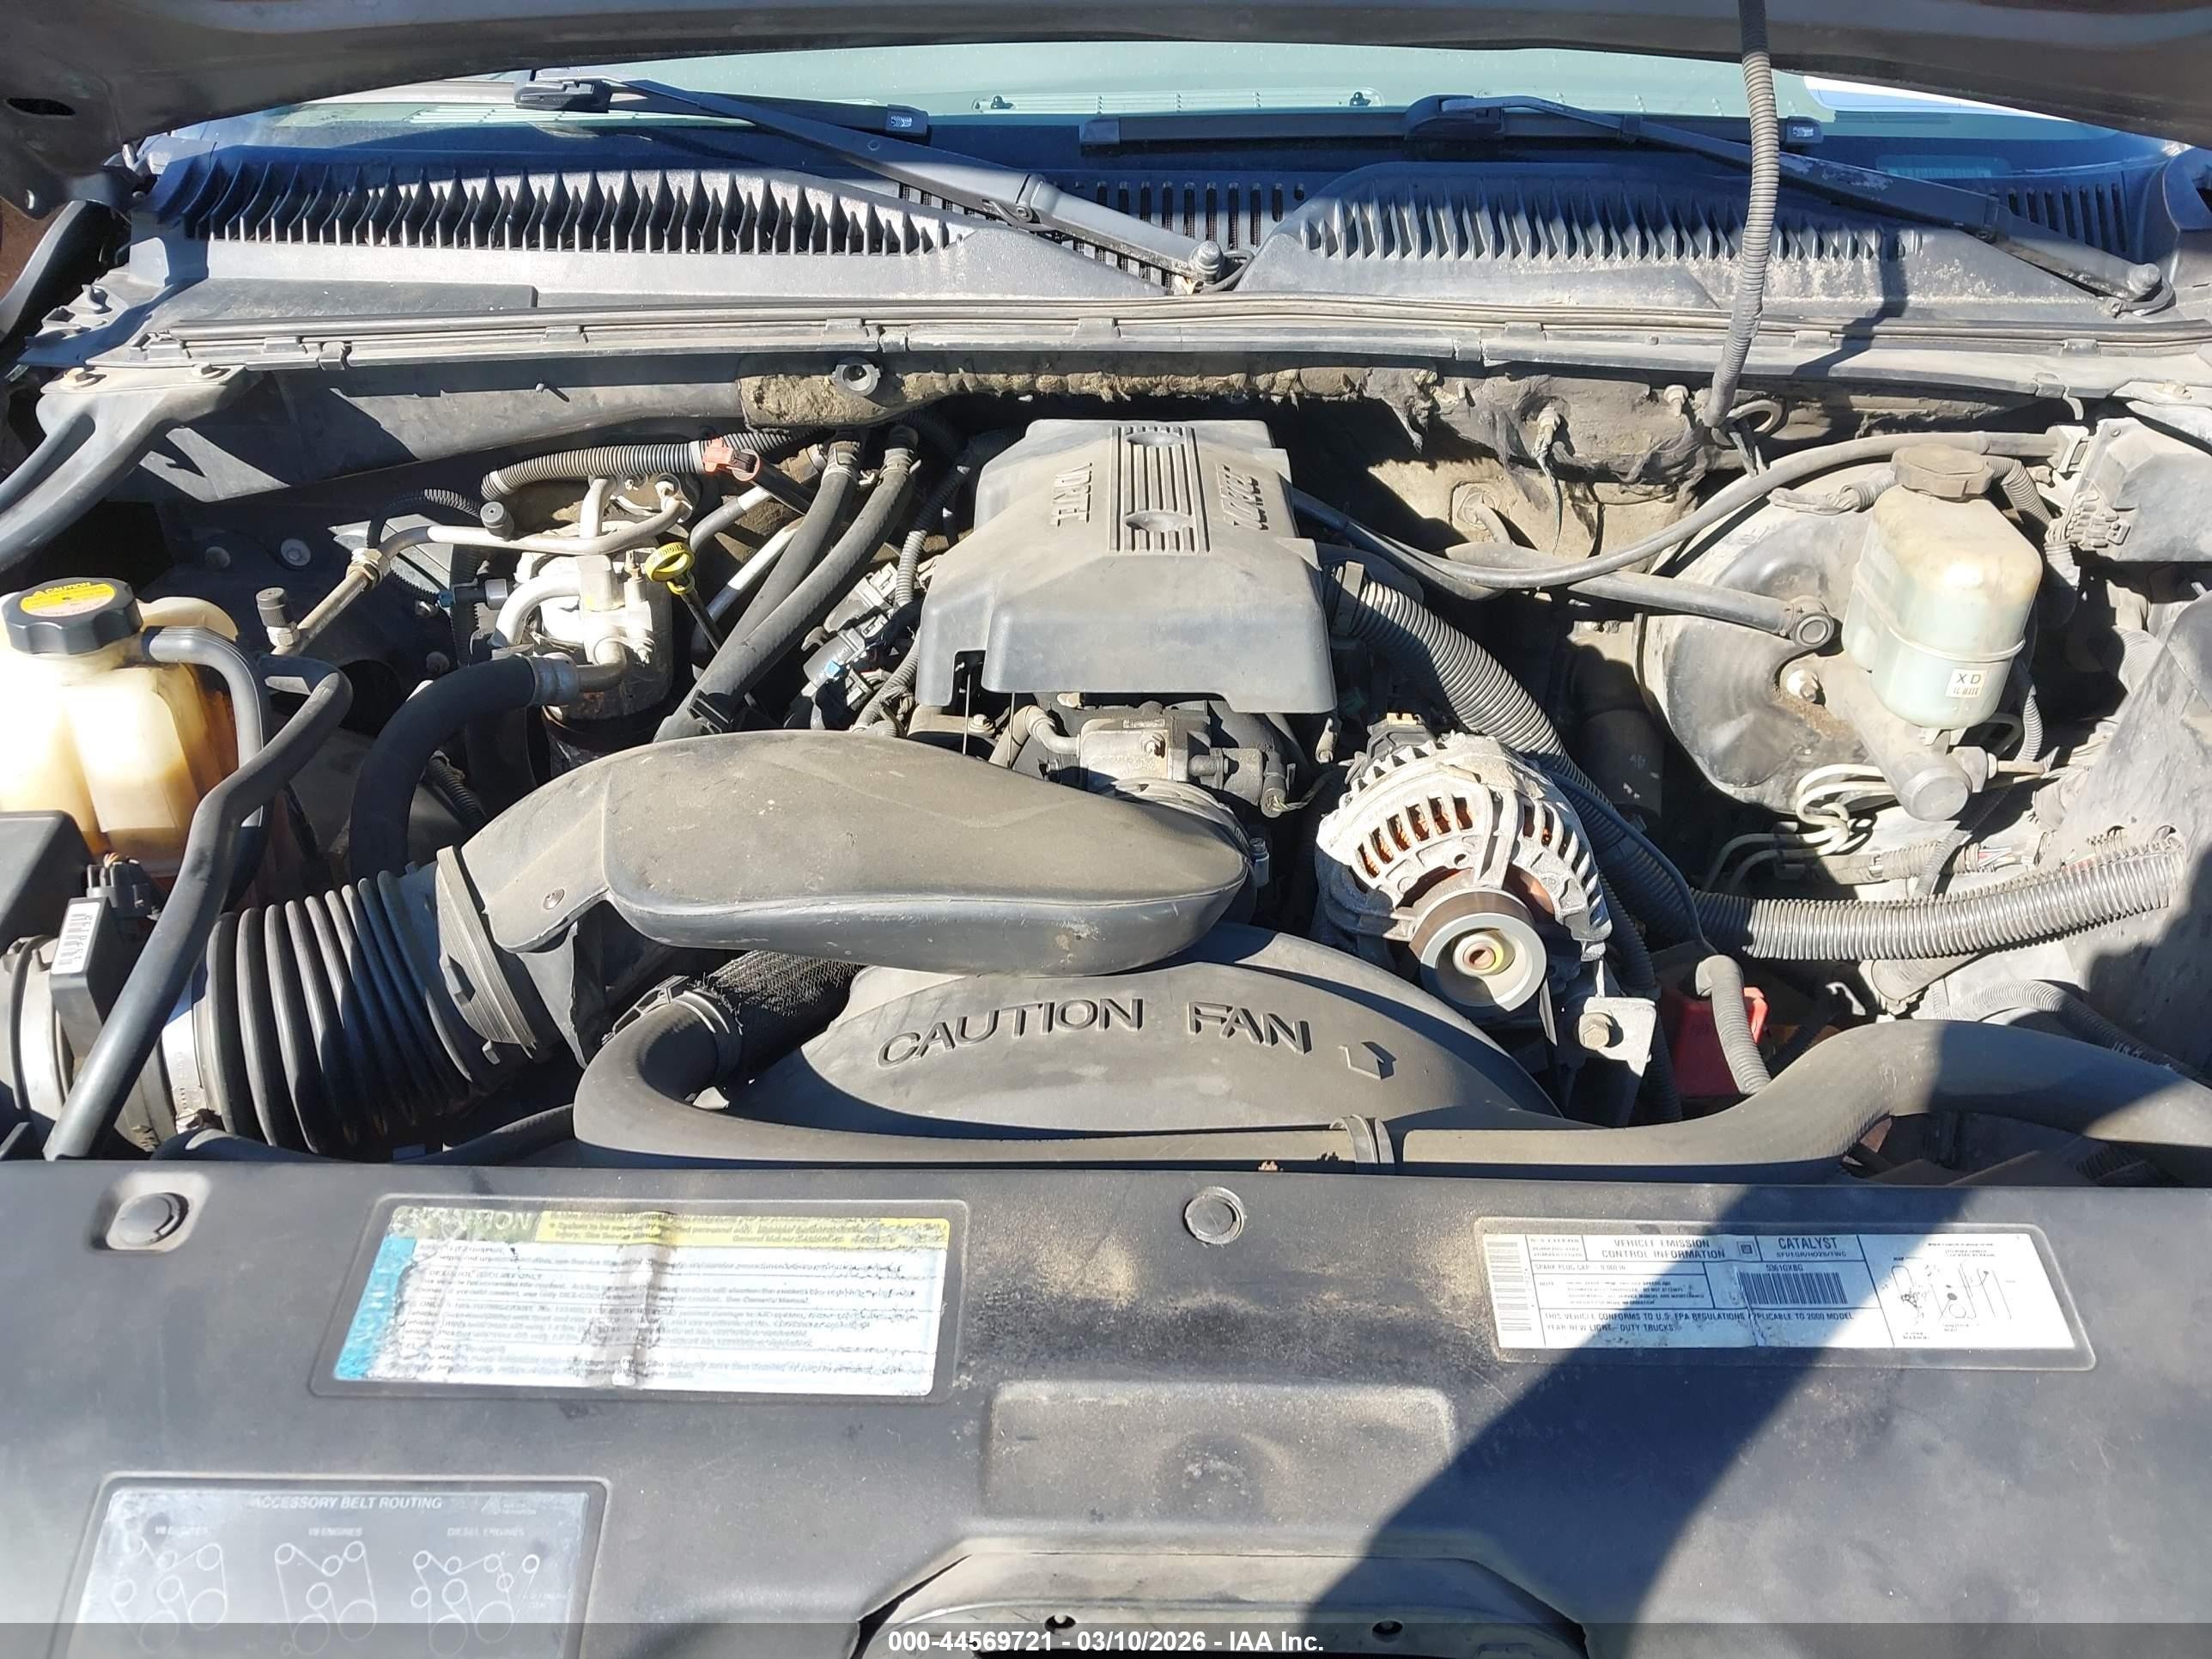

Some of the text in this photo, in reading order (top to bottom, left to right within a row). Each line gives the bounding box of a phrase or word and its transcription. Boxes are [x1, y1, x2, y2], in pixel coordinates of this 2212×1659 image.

[45, 581, 92, 594] CAUTION
[877, 997, 1313, 1067] CAUTION FAN
[1613, 1238, 1710, 1249] VEHICLE EMISSION
[1778, 1237, 1838, 1249] CATALYST
[1601, 1249, 1725, 1259] CONTROL INFORMATION
[1692, 1312, 1745, 1321] REGULATIONS
[1795, 1312, 1804, 1321] TO
[1826, 1312, 1855, 1321] MODEL
[1589, 1323, 1611, 1332] LIGHT
[1620, 1323, 1640, 1332] DUTY
[252, 1496, 444, 1510] ACCESSORY BELT ROUTING
